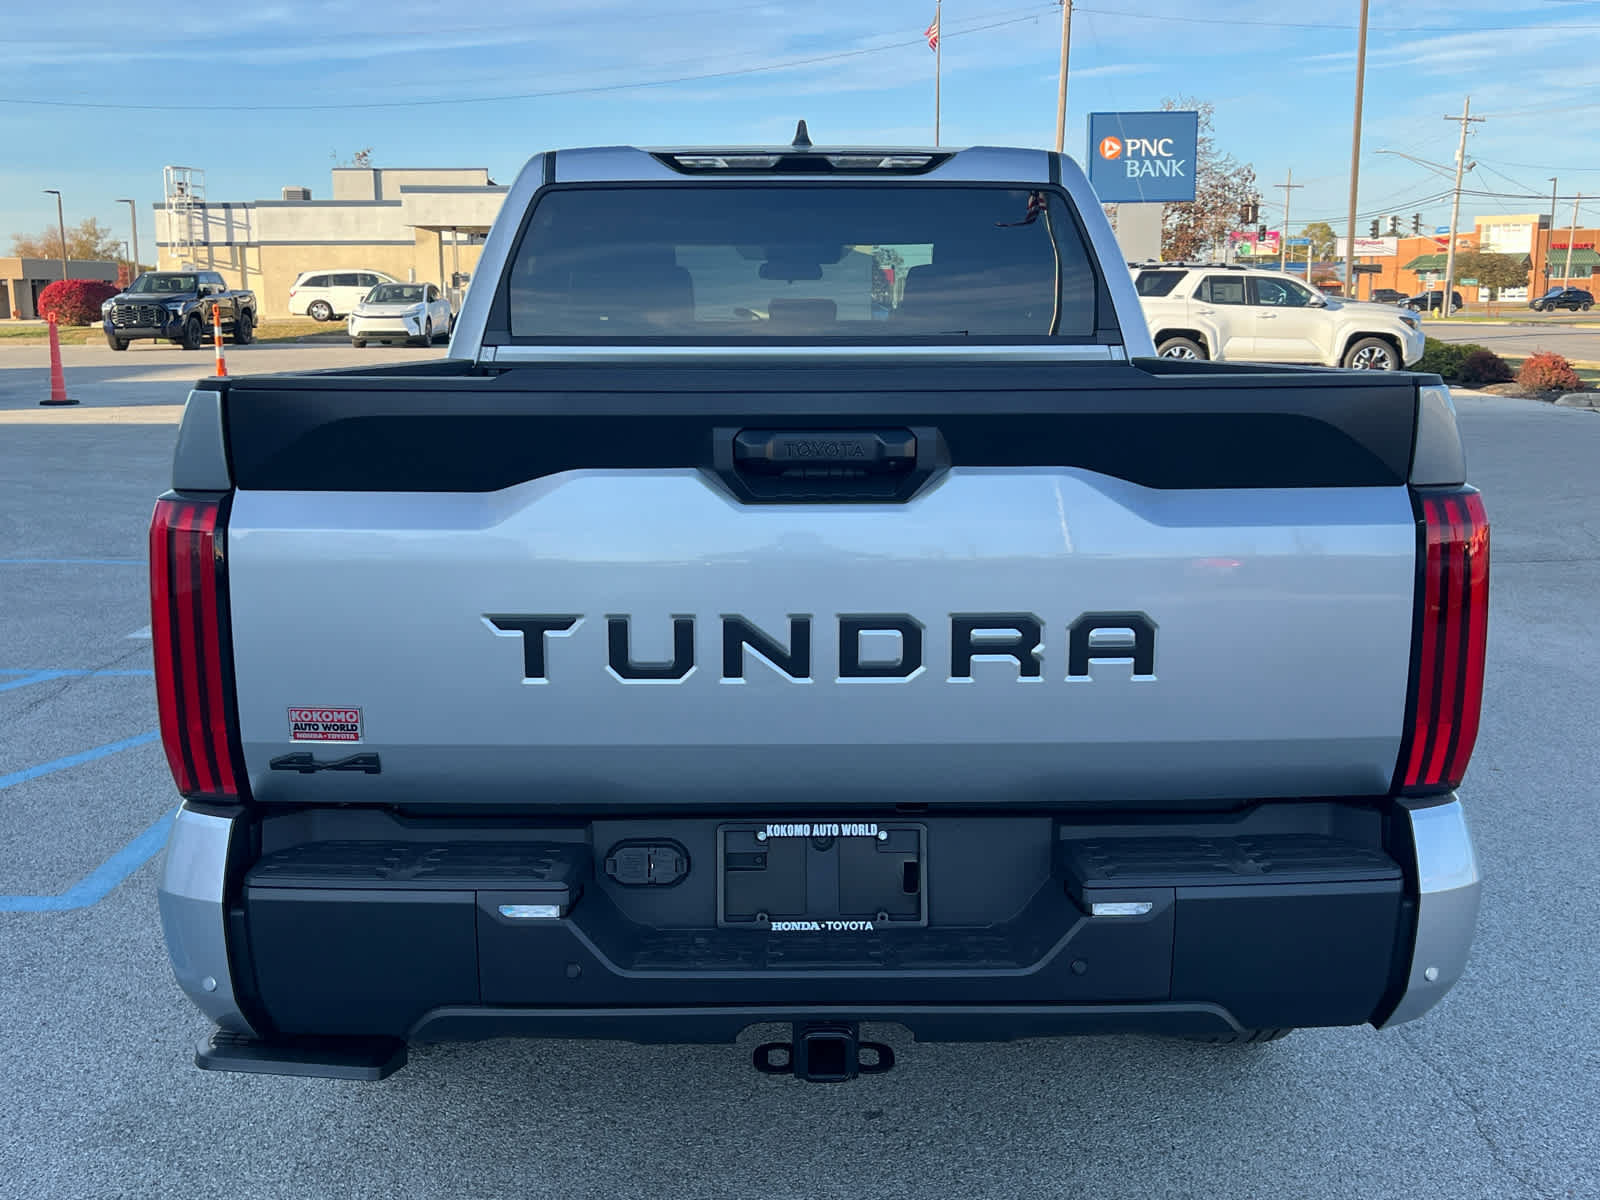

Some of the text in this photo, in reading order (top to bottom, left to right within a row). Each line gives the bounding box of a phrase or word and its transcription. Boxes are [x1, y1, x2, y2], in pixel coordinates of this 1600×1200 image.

[1125, 138, 1174, 157] PNC
[1124, 159, 1186, 178] BANK
[784, 440, 865, 457] TOYOTA
[481, 611, 1160, 686] TUNDRA
[291, 710, 358, 722] KOKOMO
[293, 723, 358, 732] AUTO WORLD
[766, 823, 878, 837] KOKOMO AUTO WORLD
